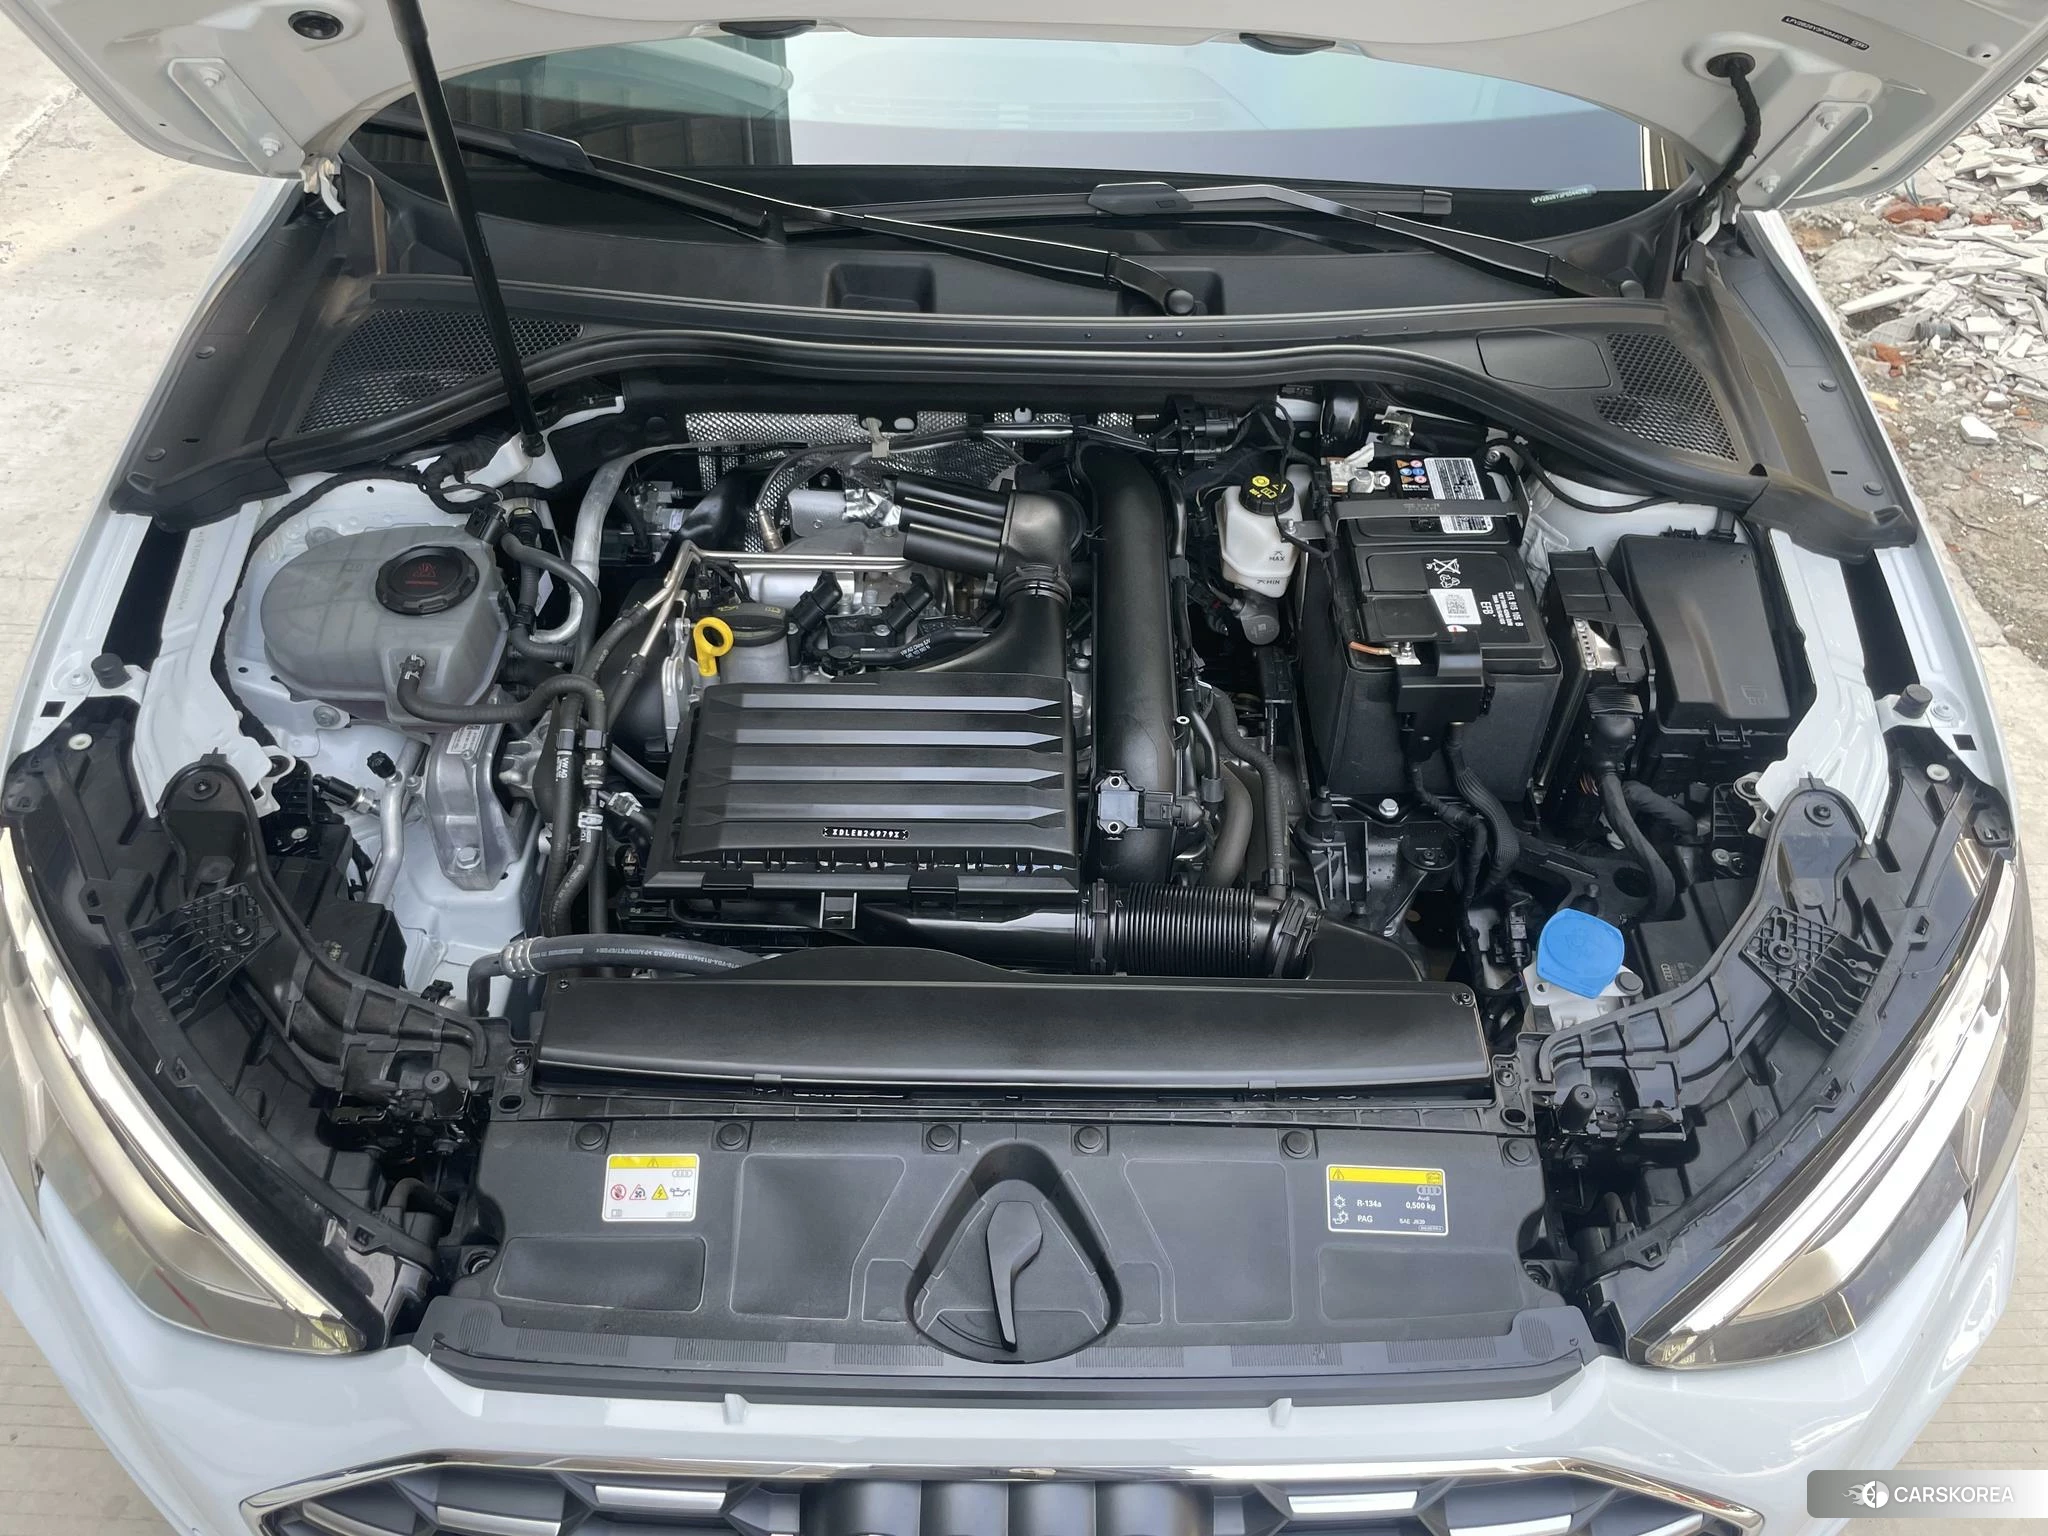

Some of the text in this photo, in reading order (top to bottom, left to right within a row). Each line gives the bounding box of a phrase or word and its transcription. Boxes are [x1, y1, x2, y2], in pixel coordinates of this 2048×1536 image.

[1356, 1199, 1382, 1208] R-134a
[1426, 1203, 1436, 1211] kg
[1357, 1215, 1373, 1223] PAG
